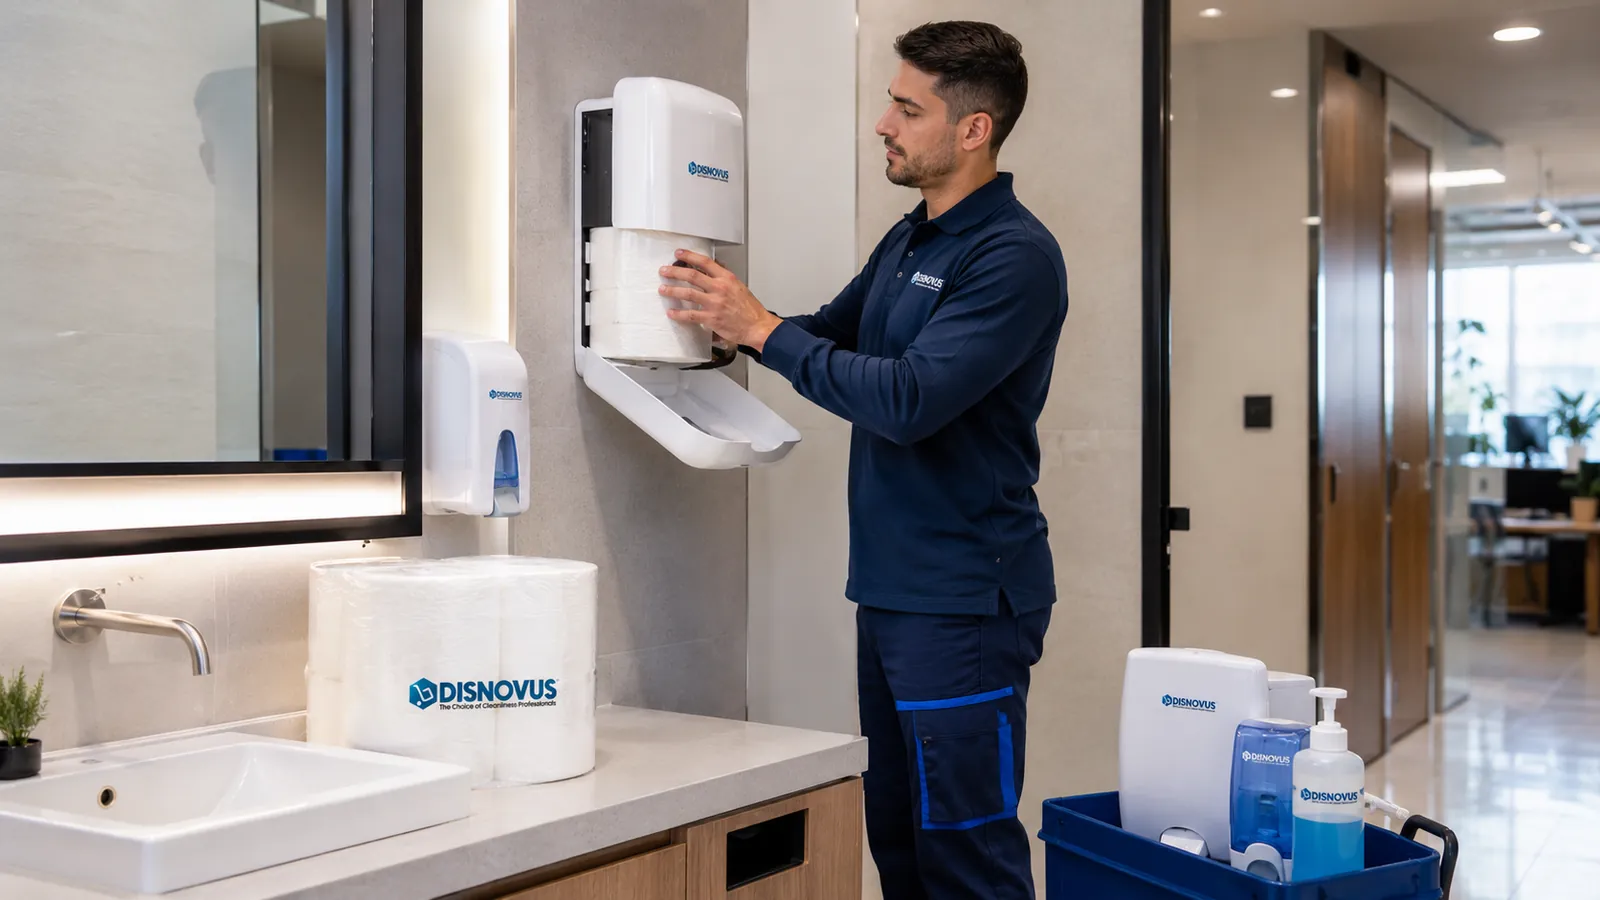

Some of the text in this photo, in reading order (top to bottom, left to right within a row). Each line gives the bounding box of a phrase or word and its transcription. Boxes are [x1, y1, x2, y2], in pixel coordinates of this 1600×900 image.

[697, 164, 729, 179] DISNOVUS
[440, 679, 557, 703] DISNOVUS
[482, 701, 517, 709] Cleanliness
[518, 699, 556, 708] Professionals
[1172, 696, 1216, 709] DISNOVUS
[1311, 791, 1358, 801] DISNOVUS
